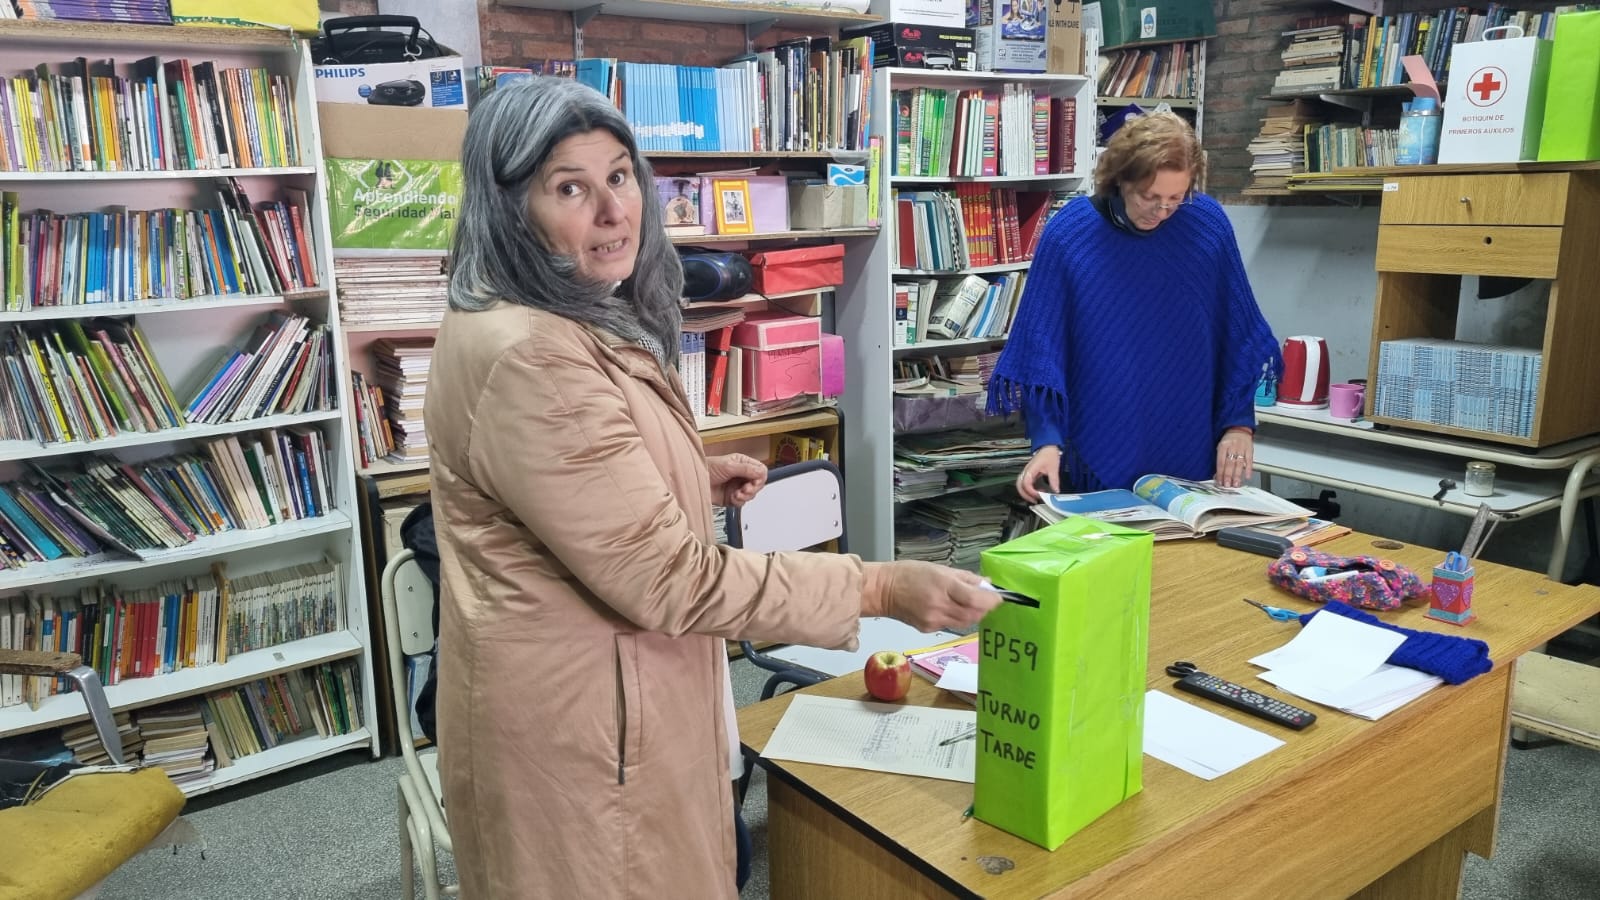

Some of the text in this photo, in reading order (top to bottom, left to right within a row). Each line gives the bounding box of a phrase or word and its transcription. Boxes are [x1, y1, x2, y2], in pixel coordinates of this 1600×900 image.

[315, 67, 366, 79] PHILIPS
[686, 334, 690, 343] 2
[693, 333, 698, 341] 3
[982, 628, 1038, 671] EP59
[979, 690, 1041, 731] TURNO
[980, 729, 1036, 770] TARDE
